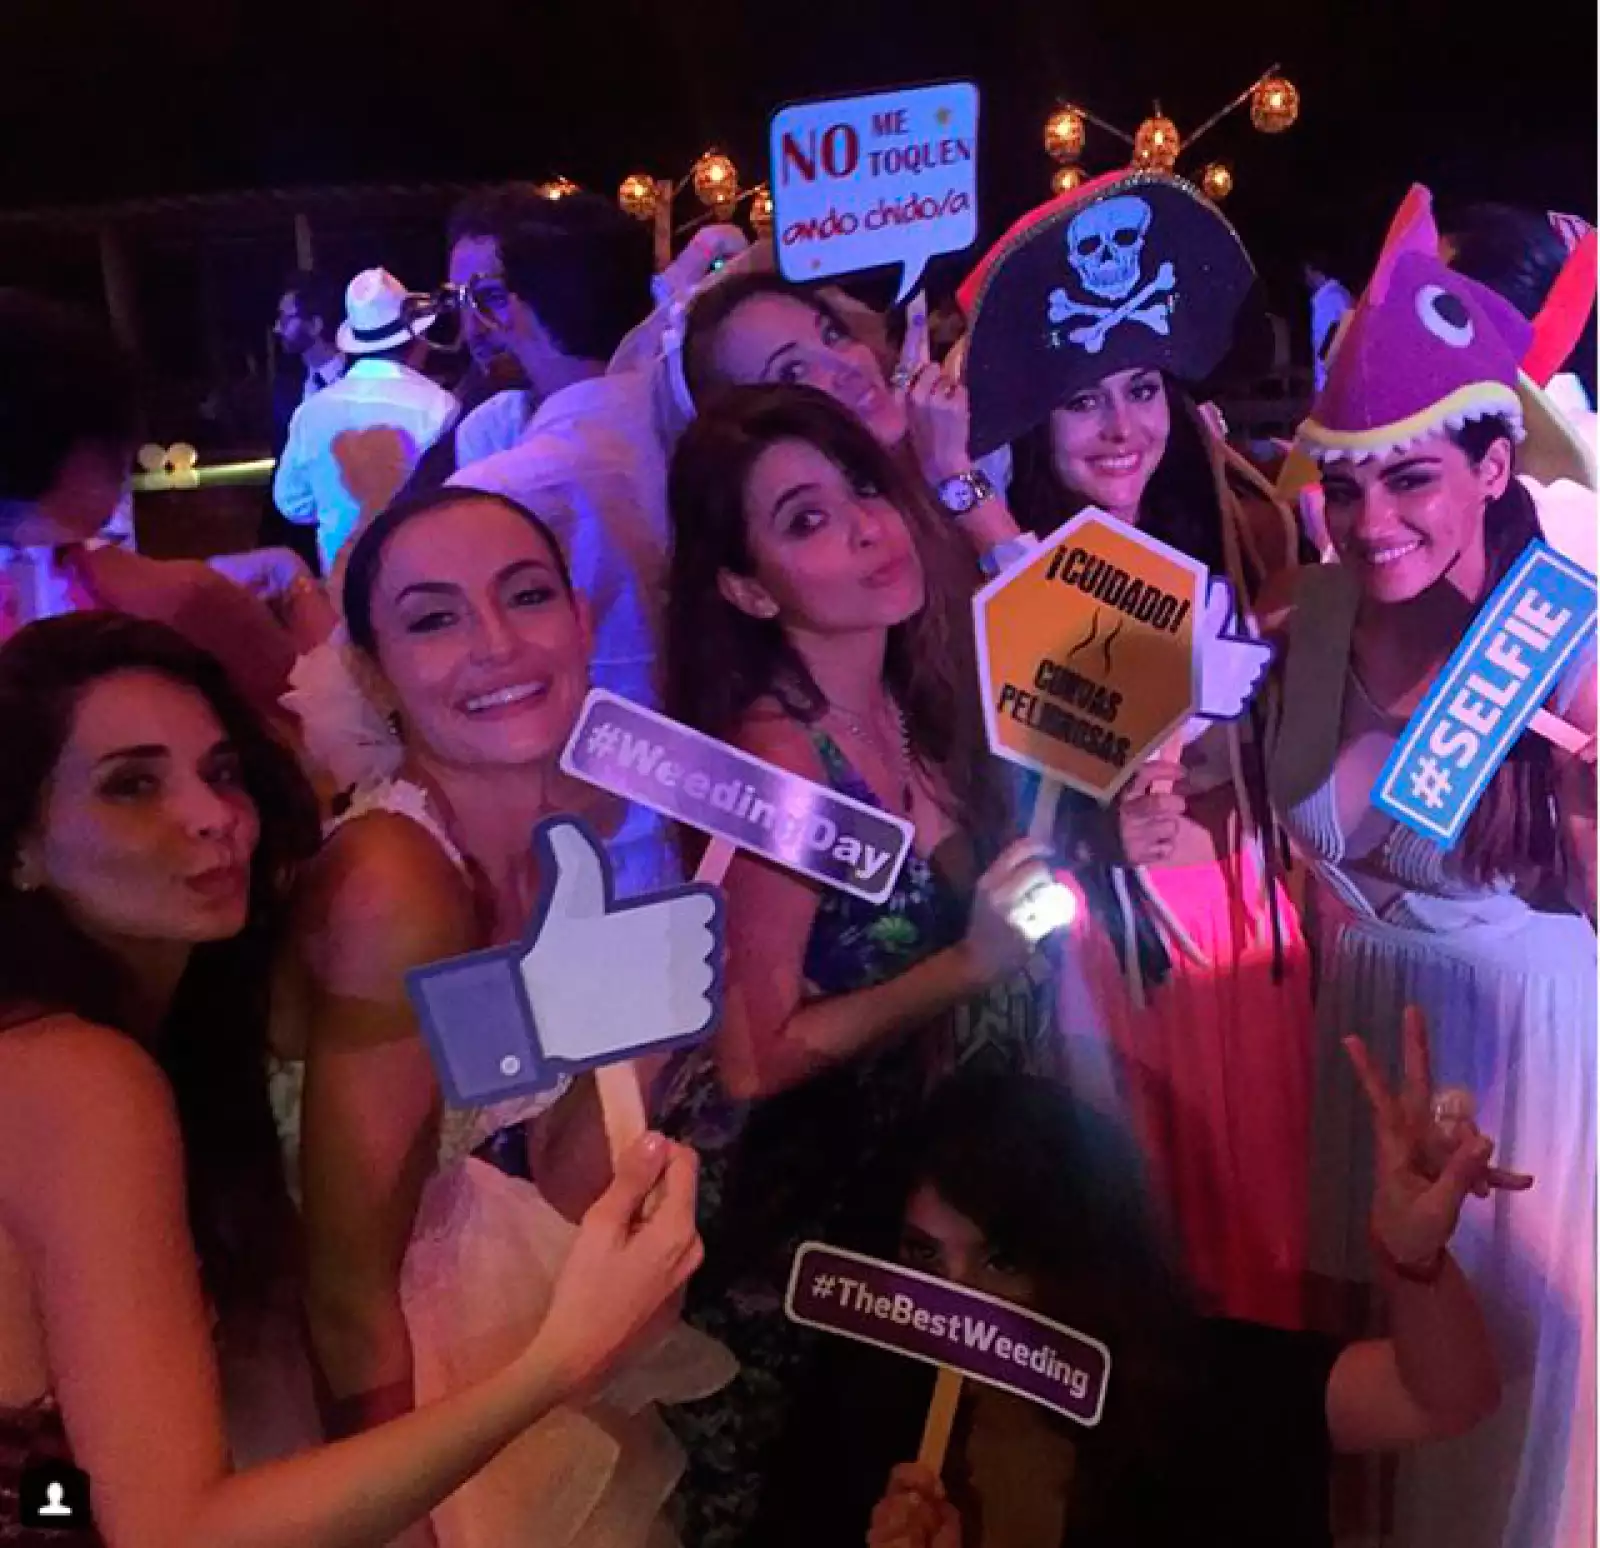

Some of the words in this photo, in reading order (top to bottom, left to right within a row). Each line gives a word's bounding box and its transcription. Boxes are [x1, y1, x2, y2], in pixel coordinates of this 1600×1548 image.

[782, 122, 860, 188] NO
[867, 138, 972, 178] TOQUEN
[871, 108, 910, 137] ME
[1045, 544, 1191, 635] ¡CUIDADO!
[995, 682, 1131, 768] PELROSAS
[1410, 588, 1572, 809] #SELFIE
[811, 1272, 1091, 1400] #TheBestWeeding
